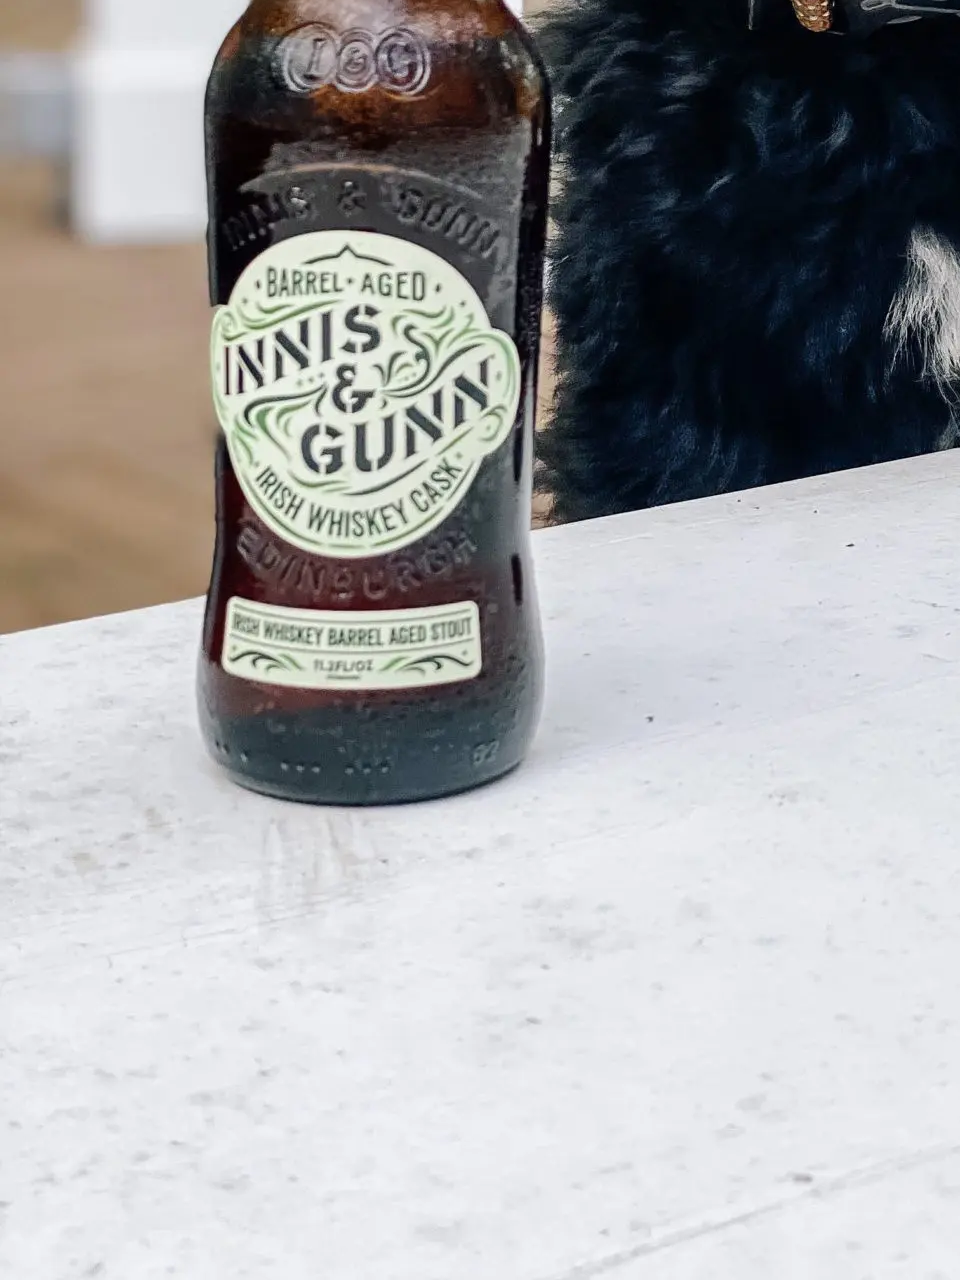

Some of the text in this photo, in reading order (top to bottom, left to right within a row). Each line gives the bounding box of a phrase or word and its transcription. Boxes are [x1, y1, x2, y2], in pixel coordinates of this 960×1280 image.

[266, 266, 427, 302] BARREL AGED
[223, 303, 382, 396] INNIS
[300, 353, 496, 475] GUNN
[331, 362, 376, 414] &
[255, 456, 464, 538] IRISH WHISKEY CASK
[232, 611, 473, 647] IRISH WHISKEY BARREL AGED STOUT
